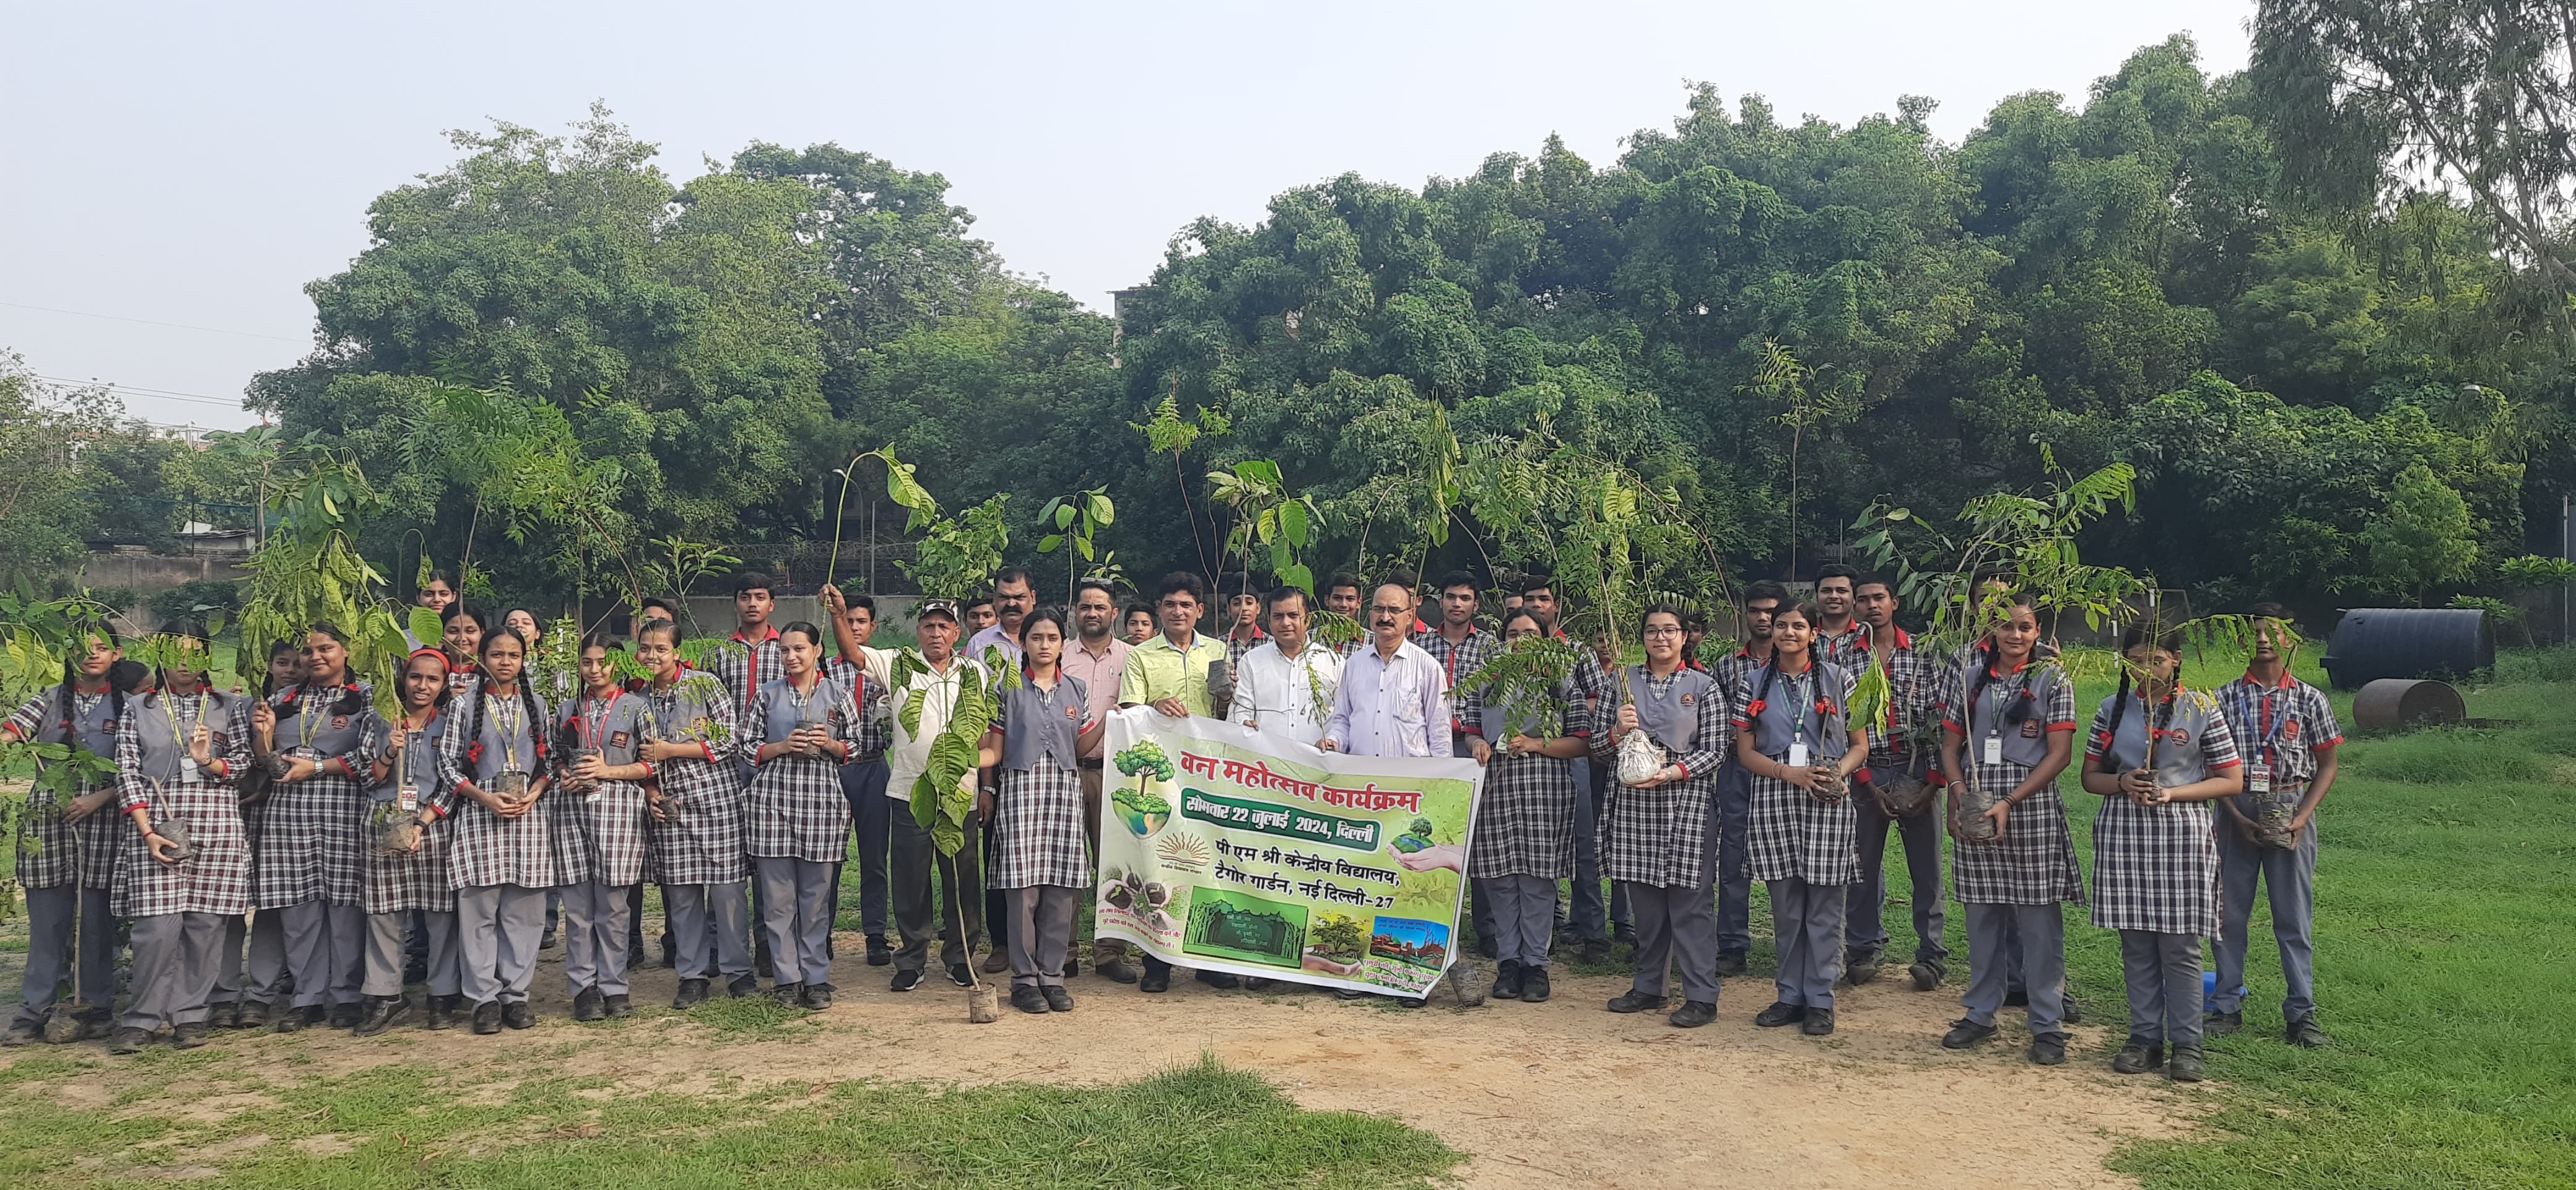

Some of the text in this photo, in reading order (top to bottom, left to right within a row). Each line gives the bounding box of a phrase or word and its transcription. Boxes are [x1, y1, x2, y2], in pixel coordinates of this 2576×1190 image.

[1180, 751, 1422, 812] वन महोत्सव कार्यक्रम
[1186, 795, 1375, 842] सोमवार 22 जुलाई 2024, दिल्ली
[1215, 838, 1399, 886] पी एम श्री केन्द्रीय विद्यालय,
[1215, 859, 1247, 884] टैगोर
[1249, 872, 1292, 895] गार्डन,
[1298, 879, 1323, 899] नई
[1323, 882, 1394, 909] दिल्ली-27
